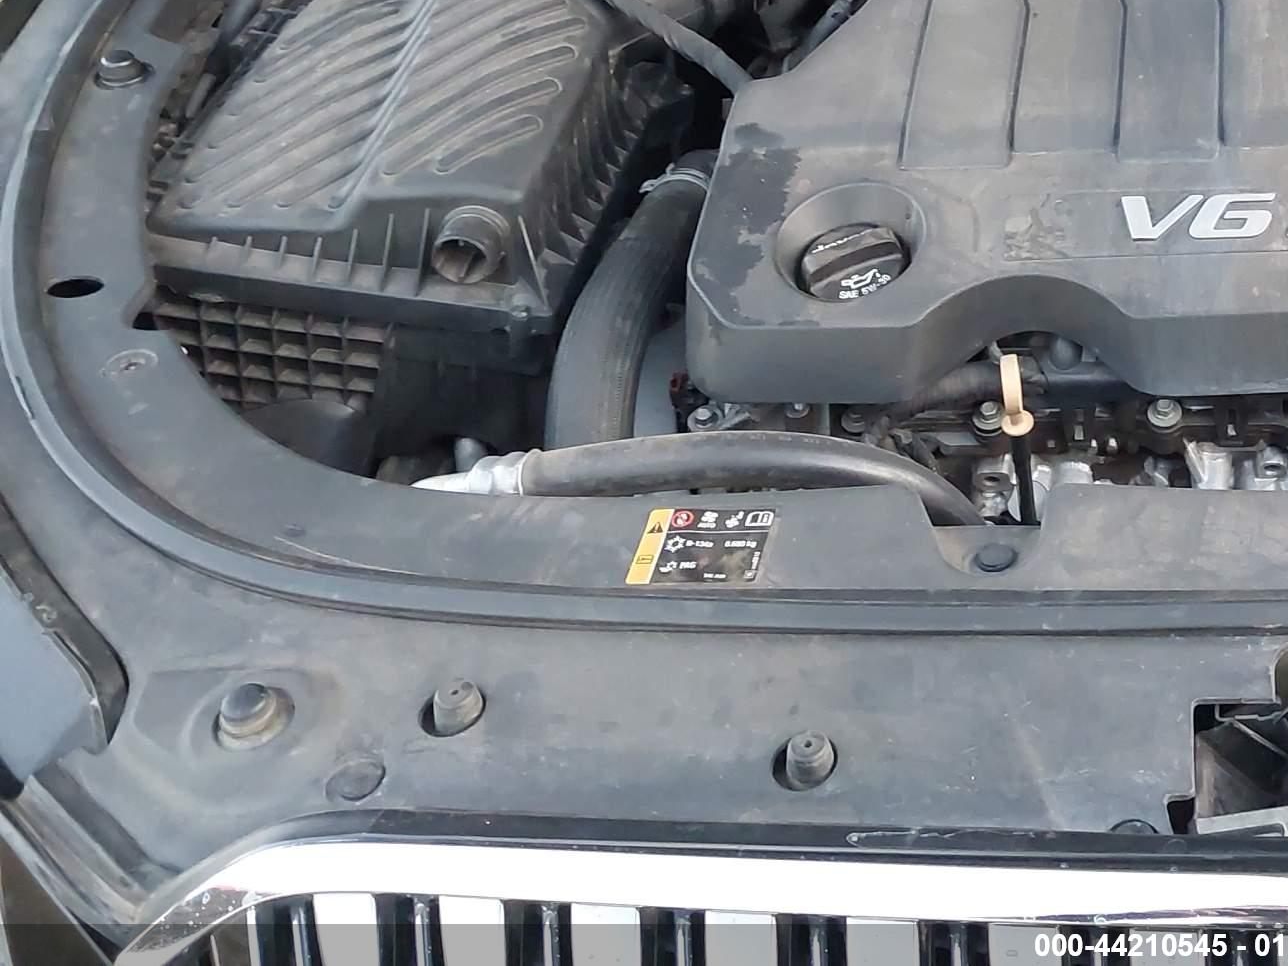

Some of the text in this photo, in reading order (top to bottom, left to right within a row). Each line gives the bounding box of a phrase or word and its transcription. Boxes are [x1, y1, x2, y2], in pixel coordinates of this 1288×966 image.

[1121, 192, 1277, 241] V6
[839, 274, 891, 299] SAE 5W-30
